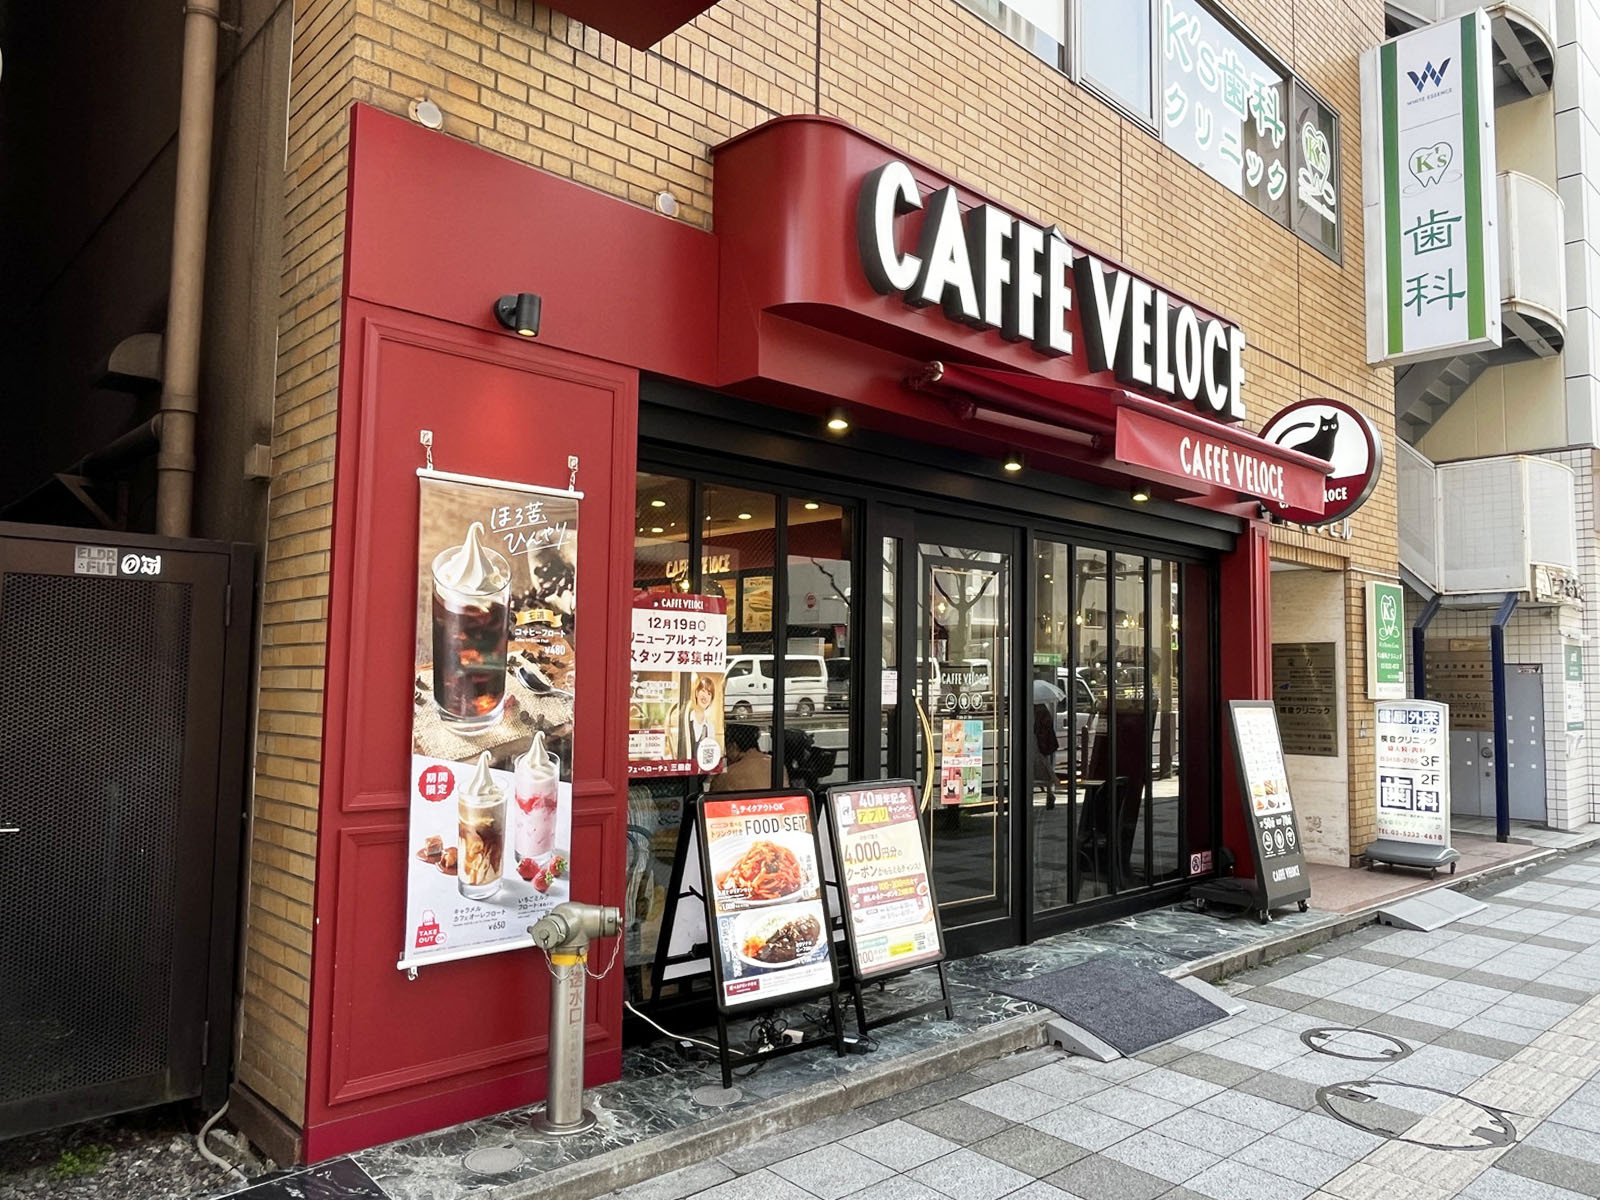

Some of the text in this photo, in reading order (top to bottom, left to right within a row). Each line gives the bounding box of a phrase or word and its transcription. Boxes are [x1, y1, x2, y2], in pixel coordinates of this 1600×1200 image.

[1406, 87, 1452, 106] WHITE ESSENCE
[1164, 81, 1288, 201] クリニック
[1414, 147, 1448, 175] K's
[1403, 208, 1466, 318] 歯科
[868, 160, 1247, 422] CAFFÈ VELOCE
[1179, 436, 1285, 500] CAFFÈ VELOCE
[1323, 486, 1348, 503] LOCE
[504, 521, 567, 553] ひんやり
[665, 554, 731, 579] CAFF ELOCE
[683, 599, 704, 610] VELOCE
[544, 644, 566, 656] ¥480
[1420, 755, 1440, 767] 3F
[425, 772, 448, 784] 期間
[1421, 774, 1440, 786] 2F
[425, 784, 448, 796] 限定
[1380, 775, 1440, 813] 歯科
[859, 791, 907, 808] 40周年記念
[739, 803, 785, 814] テイクアウトOK
[858, 808, 886, 823] アプリ
[745, 815, 807, 836] FOOD SET
[452, 909, 507, 923] カフェオーレフロート
[454, 906, 483, 916] キャラメル
[418, 928, 438, 937] TAKE
[487, 921, 507, 932] ¥650
[418, 936, 434, 945] OUT
[568, 968, 583, 1025] 送水口
